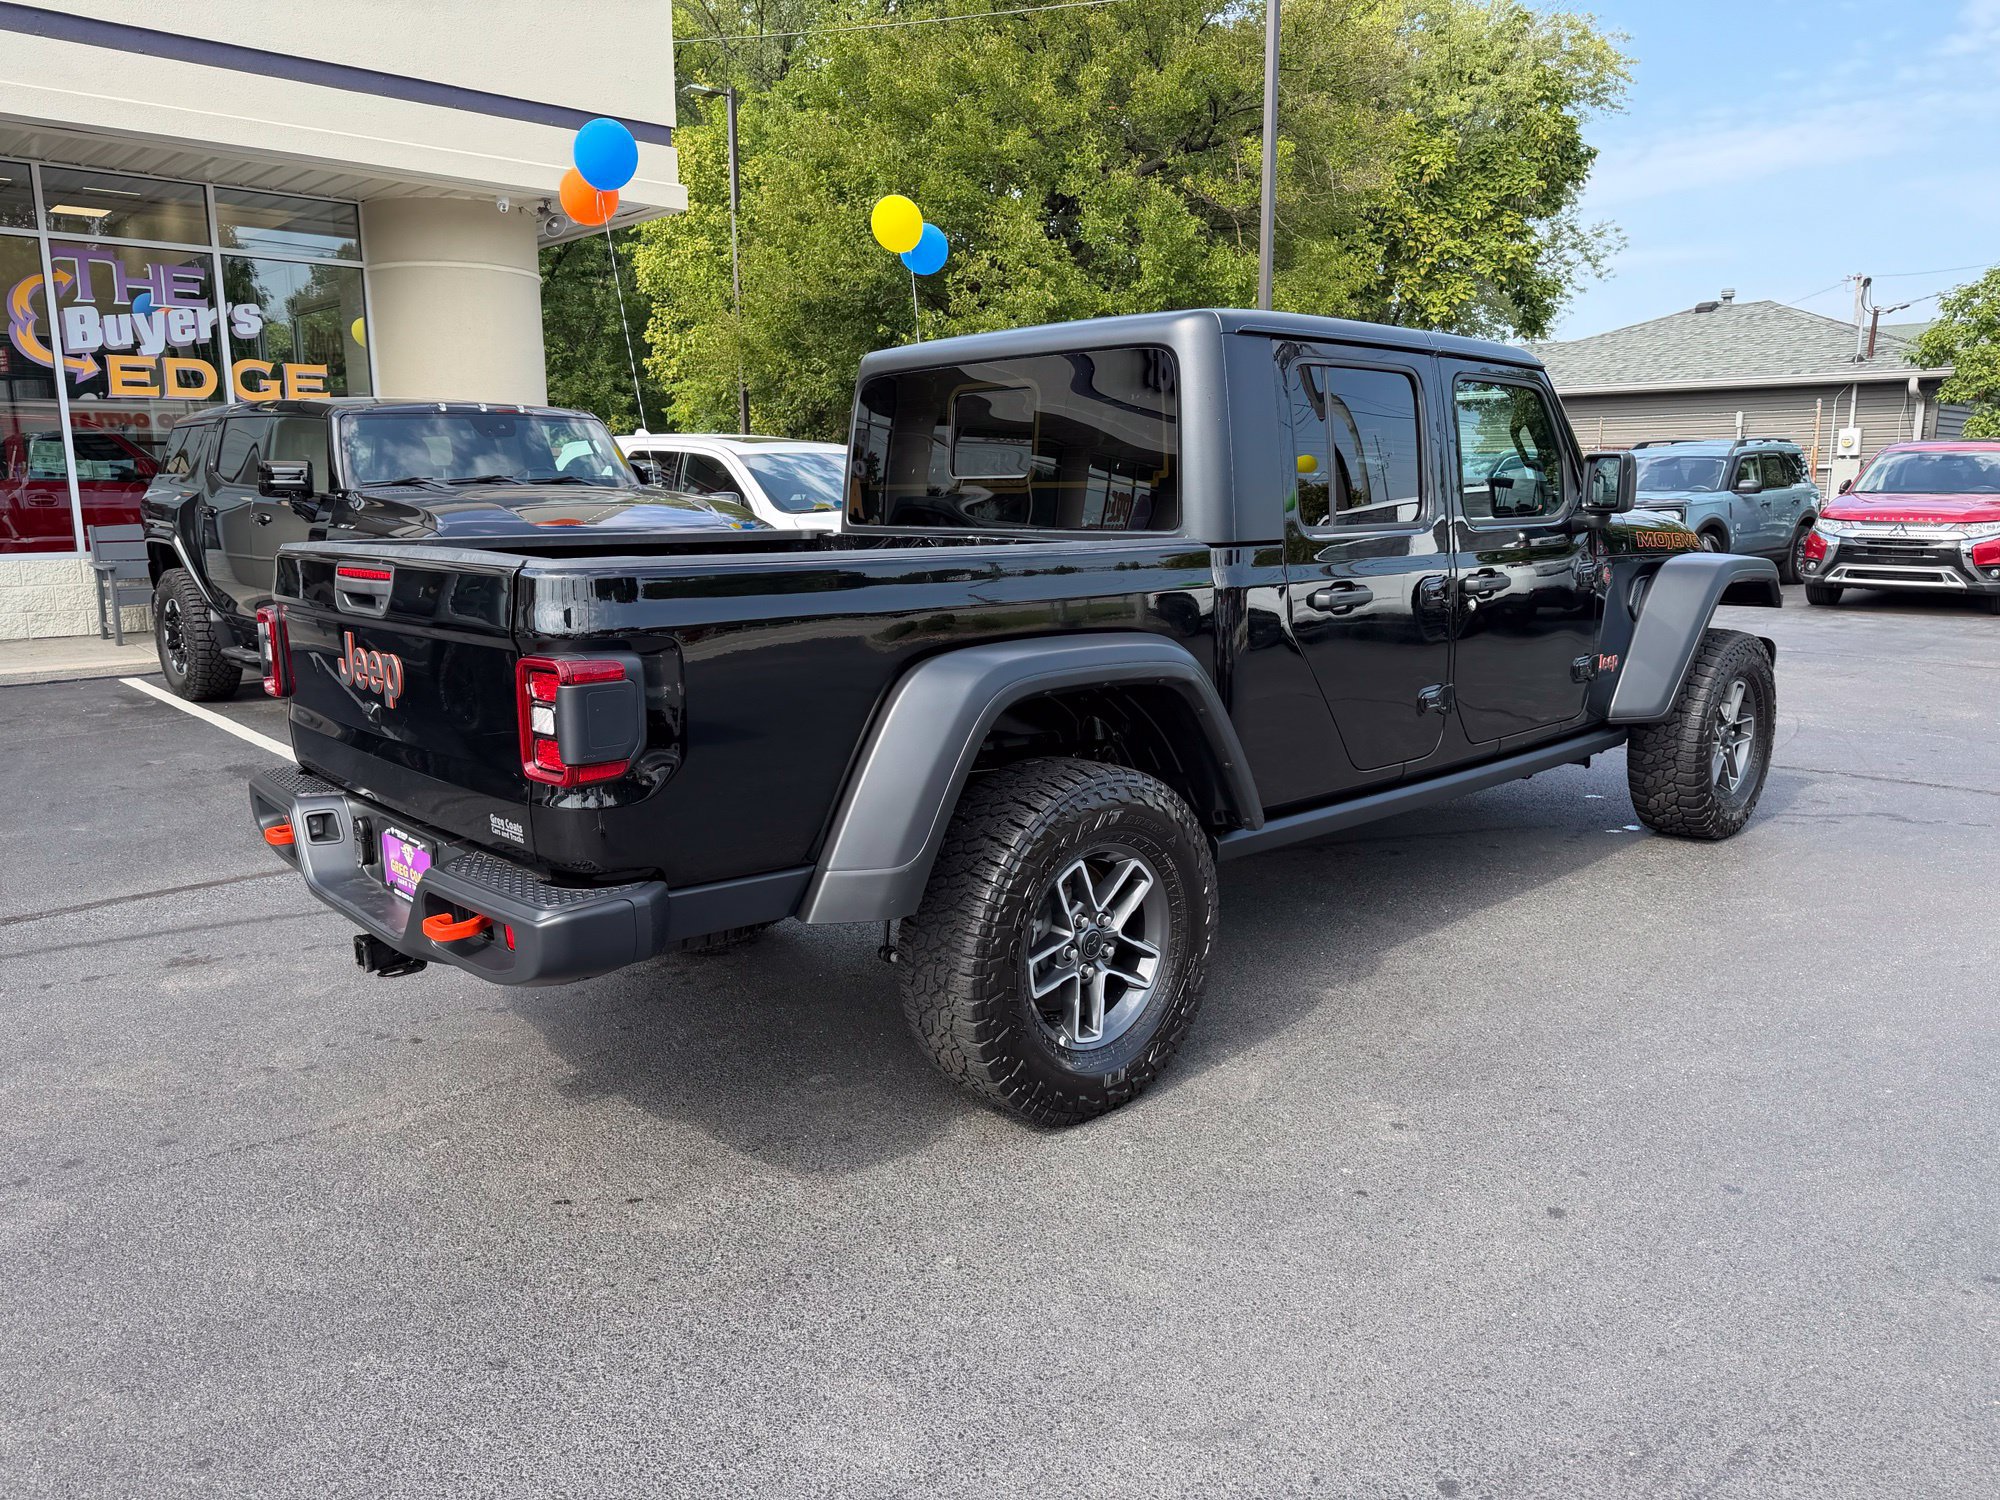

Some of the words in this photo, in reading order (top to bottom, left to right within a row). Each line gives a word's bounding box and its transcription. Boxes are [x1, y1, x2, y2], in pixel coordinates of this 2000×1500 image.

[51, 247, 208, 309] THE
[60, 302, 263, 355] Buyer's
[105, 354, 331, 400] EDGE
[1635, 531, 1701, 550] MOJAVE
[337, 631, 404, 710] Jeep
[1598, 653, 1618, 672] Jeep
[490, 813, 505, 830] Greg
[505, 818, 523, 833] Coats
